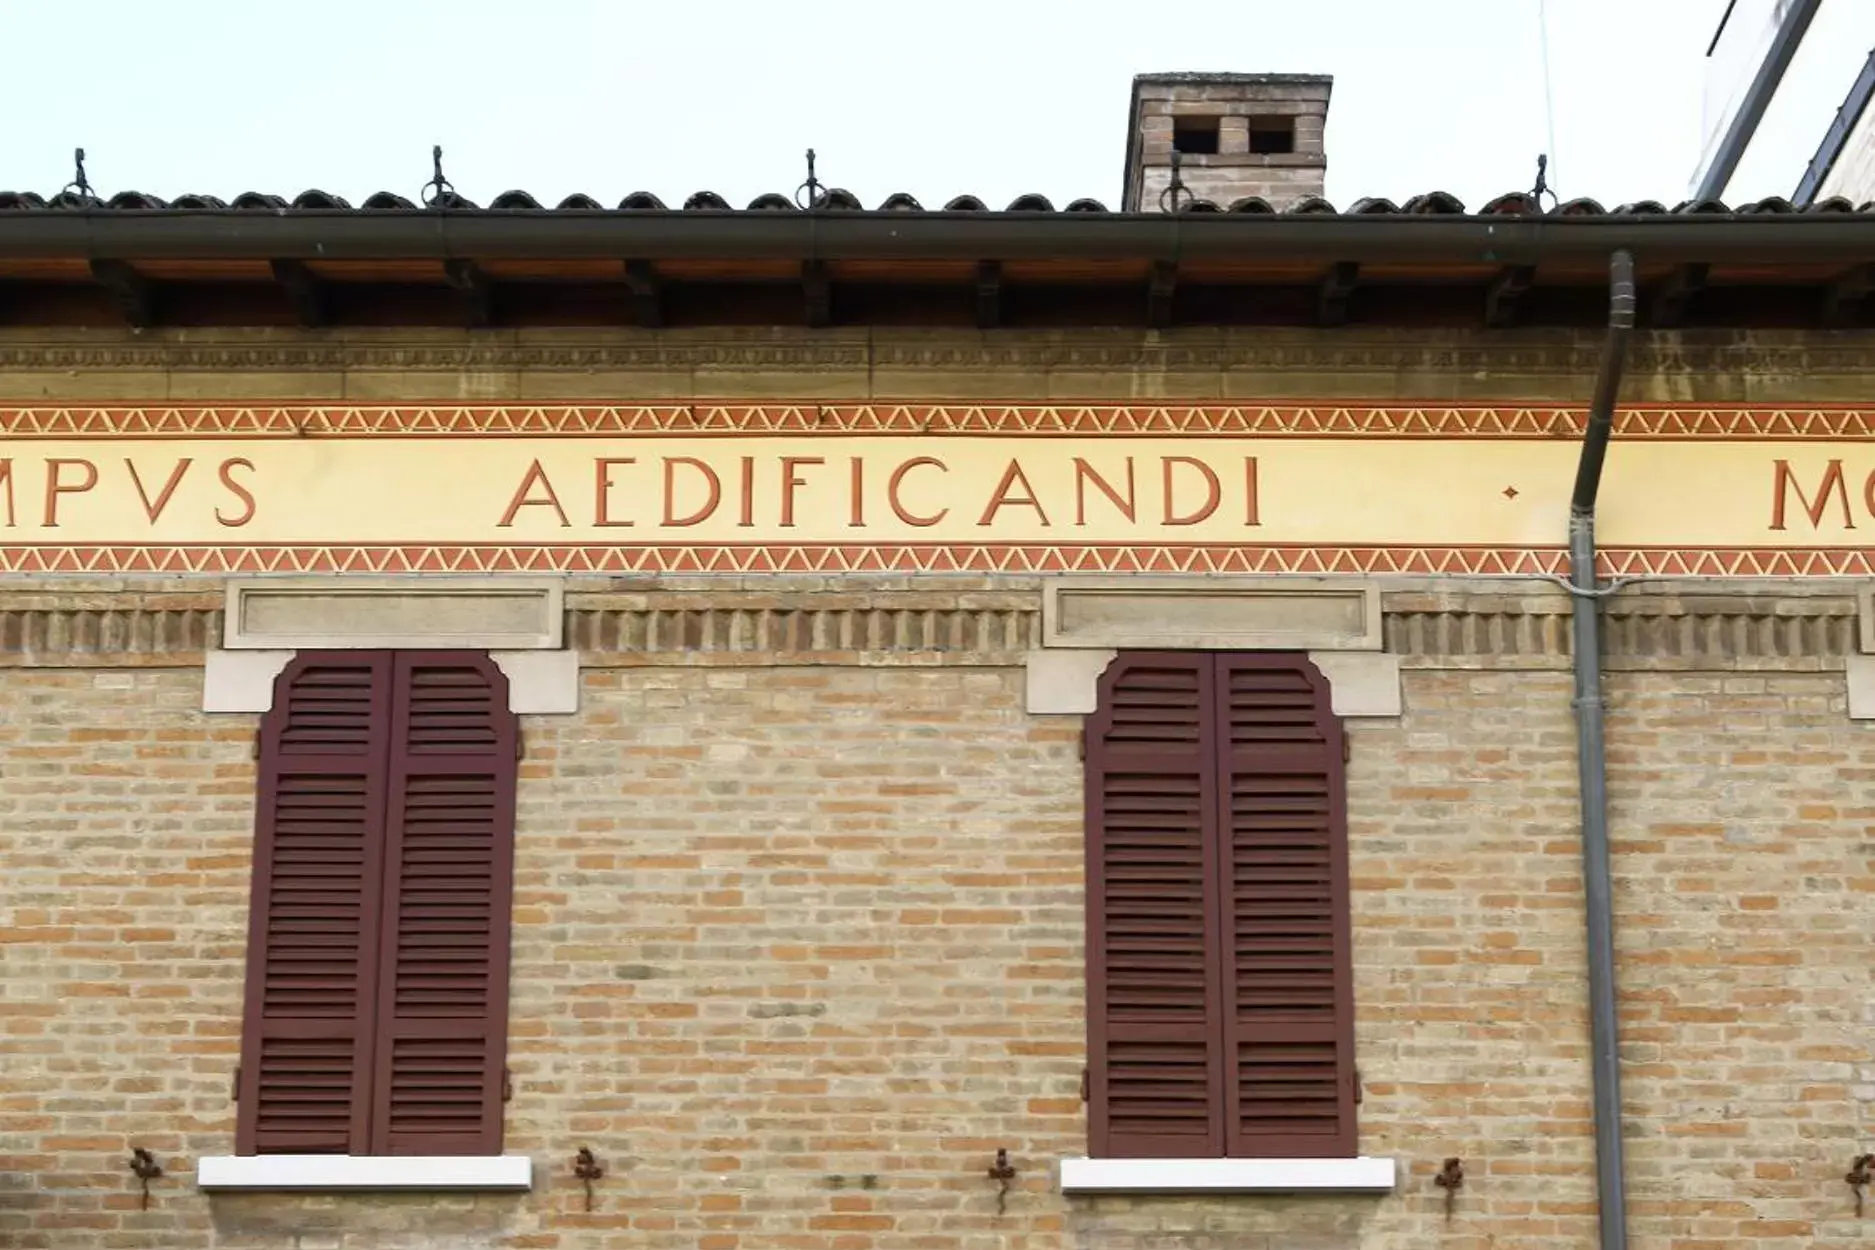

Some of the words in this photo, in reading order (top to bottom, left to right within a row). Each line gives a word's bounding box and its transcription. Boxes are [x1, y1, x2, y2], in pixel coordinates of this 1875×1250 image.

[0, 457, 256, 528] PVS
[495, 456, 1262, 528] AEDIFICANDI
[1768, 459, 1875, 531] M
